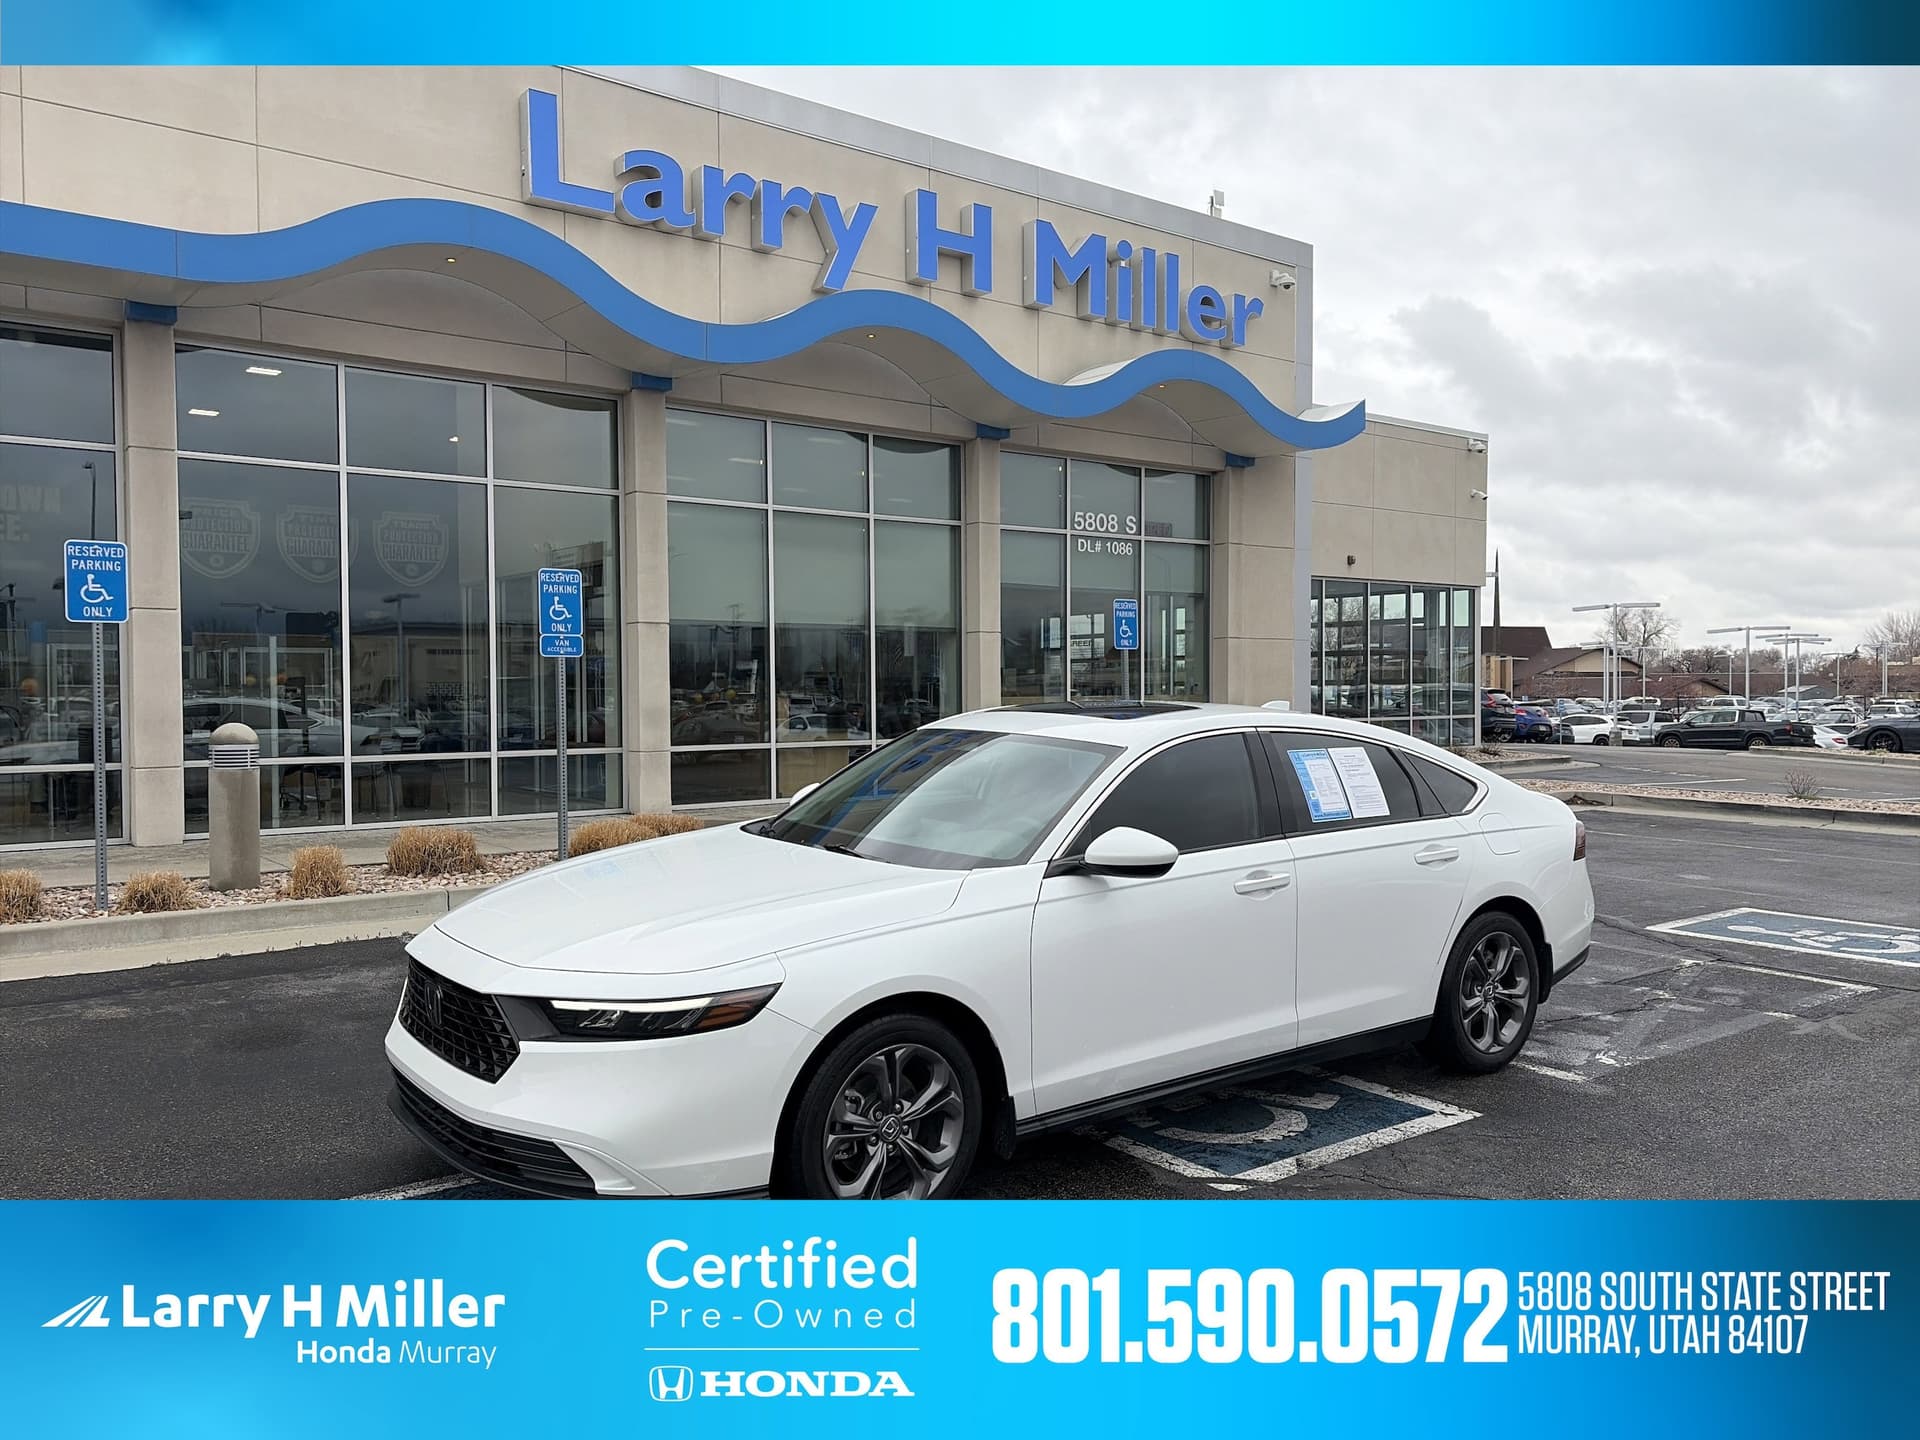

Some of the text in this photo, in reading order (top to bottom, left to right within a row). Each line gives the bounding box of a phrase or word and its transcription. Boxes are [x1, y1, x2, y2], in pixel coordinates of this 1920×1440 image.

[522, 88, 1265, 348] Larry H Miller
[1073, 511, 1119, 532] 5808
[1125, 515, 1137, 534] S
[182, 532, 250, 553] GUARANTEE
[1077, 538, 1134, 556] DL# 1086
[67, 545, 124, 558] RESERVED
[383, 544, 440, 562] GUARANTEE
[71, 559, 121, 571] PARKING
[540, 572, 580, 583] RESERVED
[543, 584, 578, 594] PARKING
[83, 606, 113, 617] ONLY
[1116, 610, 1136, 618] PARKING
[551, 622, 573, 632] ONLY
[554, 639, 570, 647] VAN
